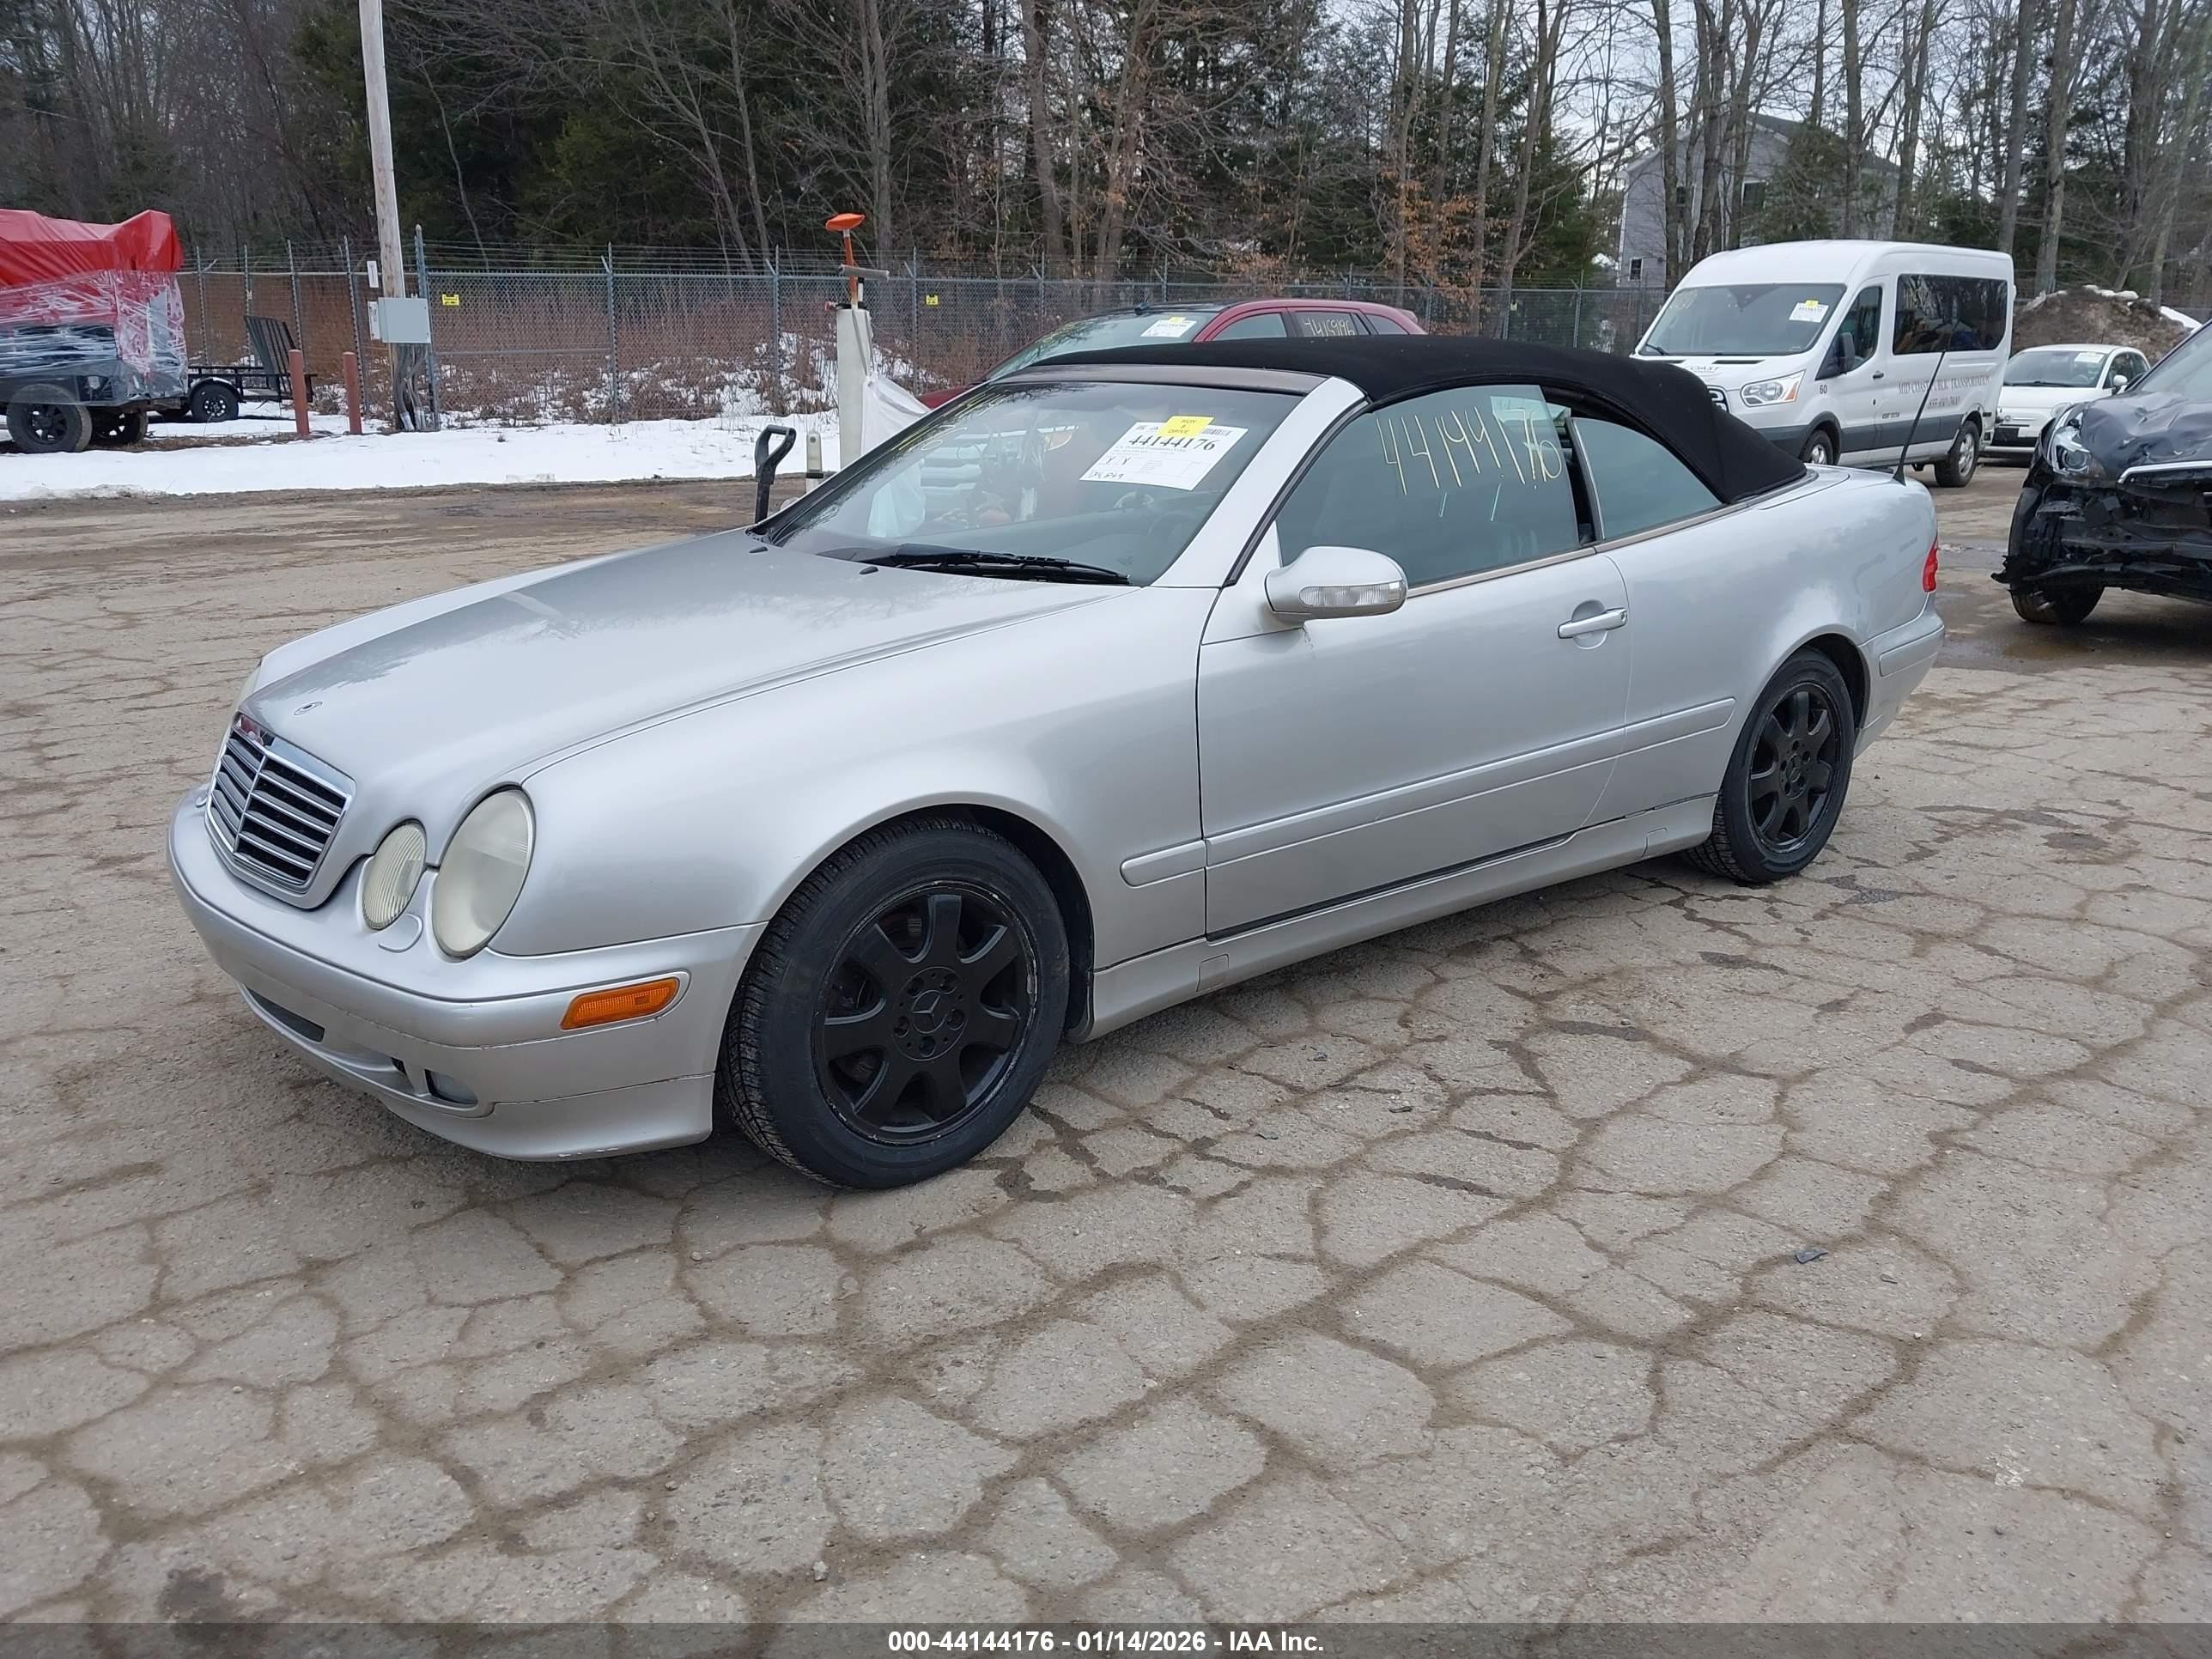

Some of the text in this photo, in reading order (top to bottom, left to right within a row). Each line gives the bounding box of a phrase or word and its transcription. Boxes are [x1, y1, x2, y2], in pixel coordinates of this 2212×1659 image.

[1820, 384, 1828, 395] 60
[1128, 434, 1220, 451] 44144176
[1376, 406, 1562, 495] 44144176
